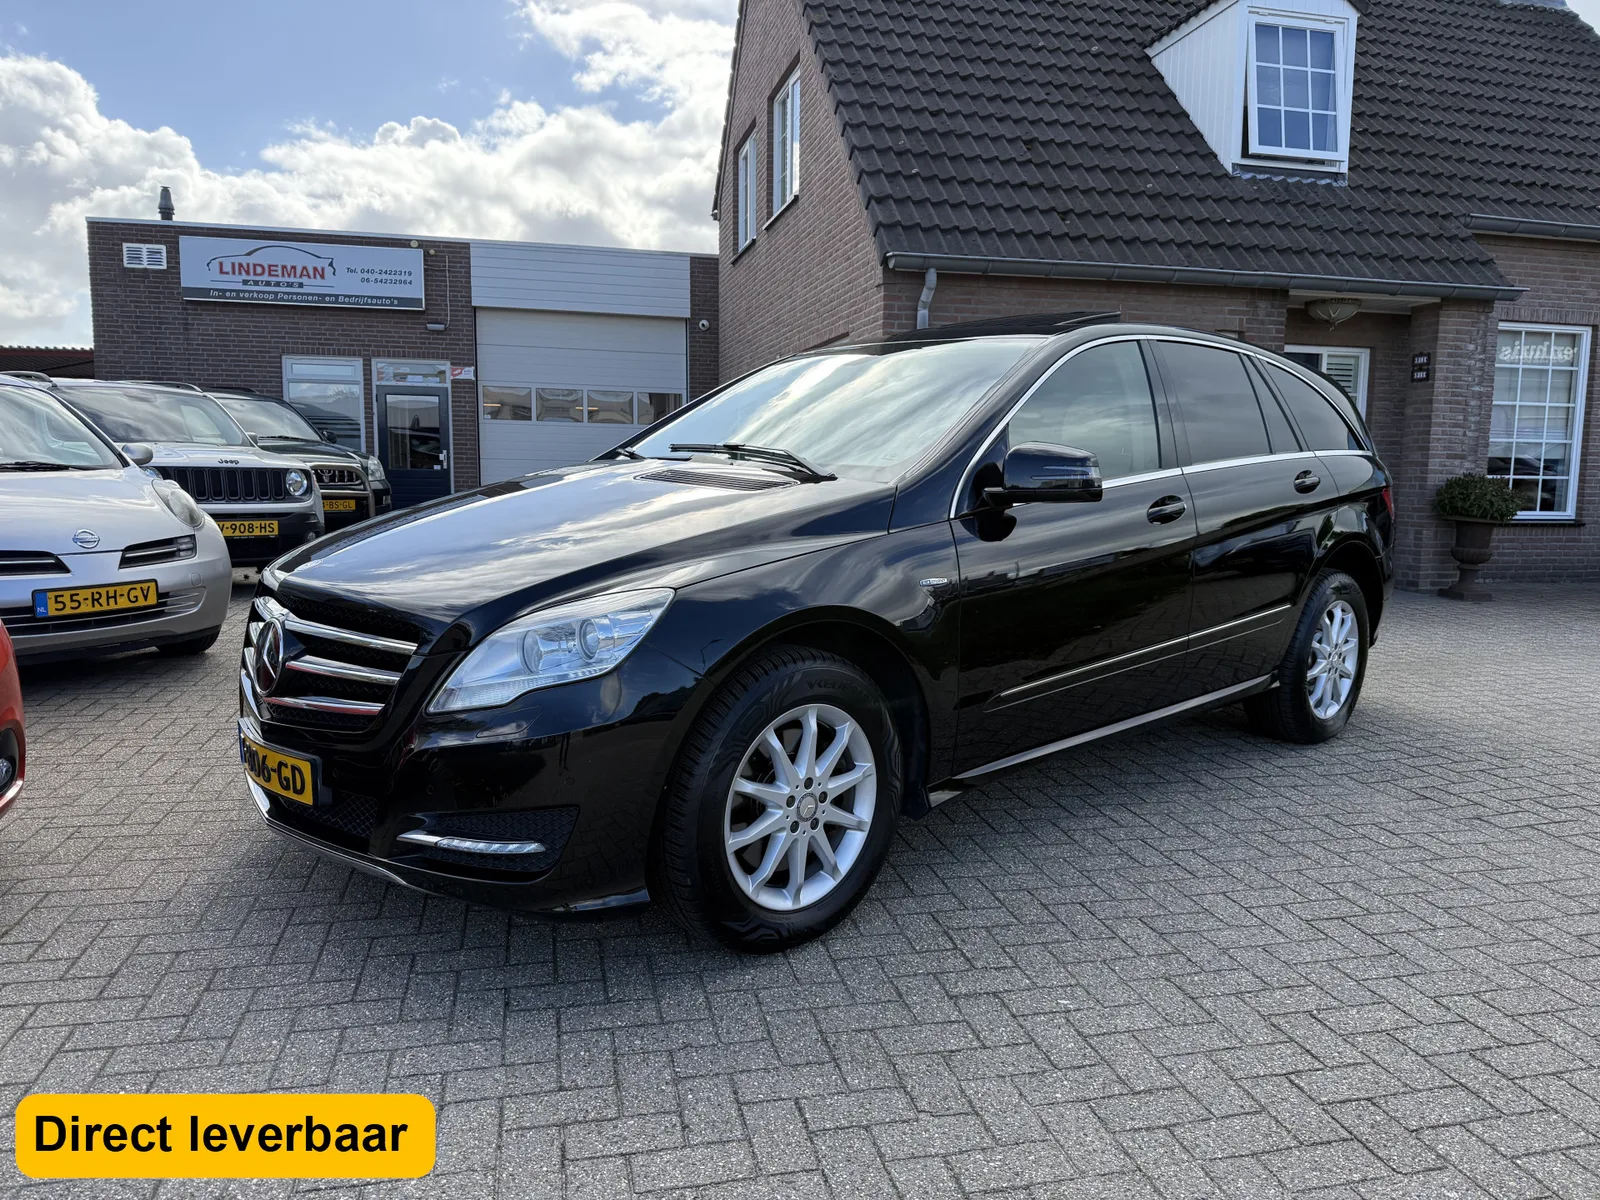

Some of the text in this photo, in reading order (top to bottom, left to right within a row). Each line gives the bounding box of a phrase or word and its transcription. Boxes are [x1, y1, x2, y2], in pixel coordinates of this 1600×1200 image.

[218, 260, 326, 280] LINDEMAN
[360, 268, 412, 277] 040-2422319
[247, 280, 300, 288] AUTO'S
[360, 277, 413, 285] 06-54232964
[210, 289, 222, 297] In-
[240, 290, 274, 300] verkoop
[277, 292, 322, 302] Personen-
[338, 295, 398, 305] Bedrijfsauto's
[54, 586, 151, 611] 55-RH-GV
